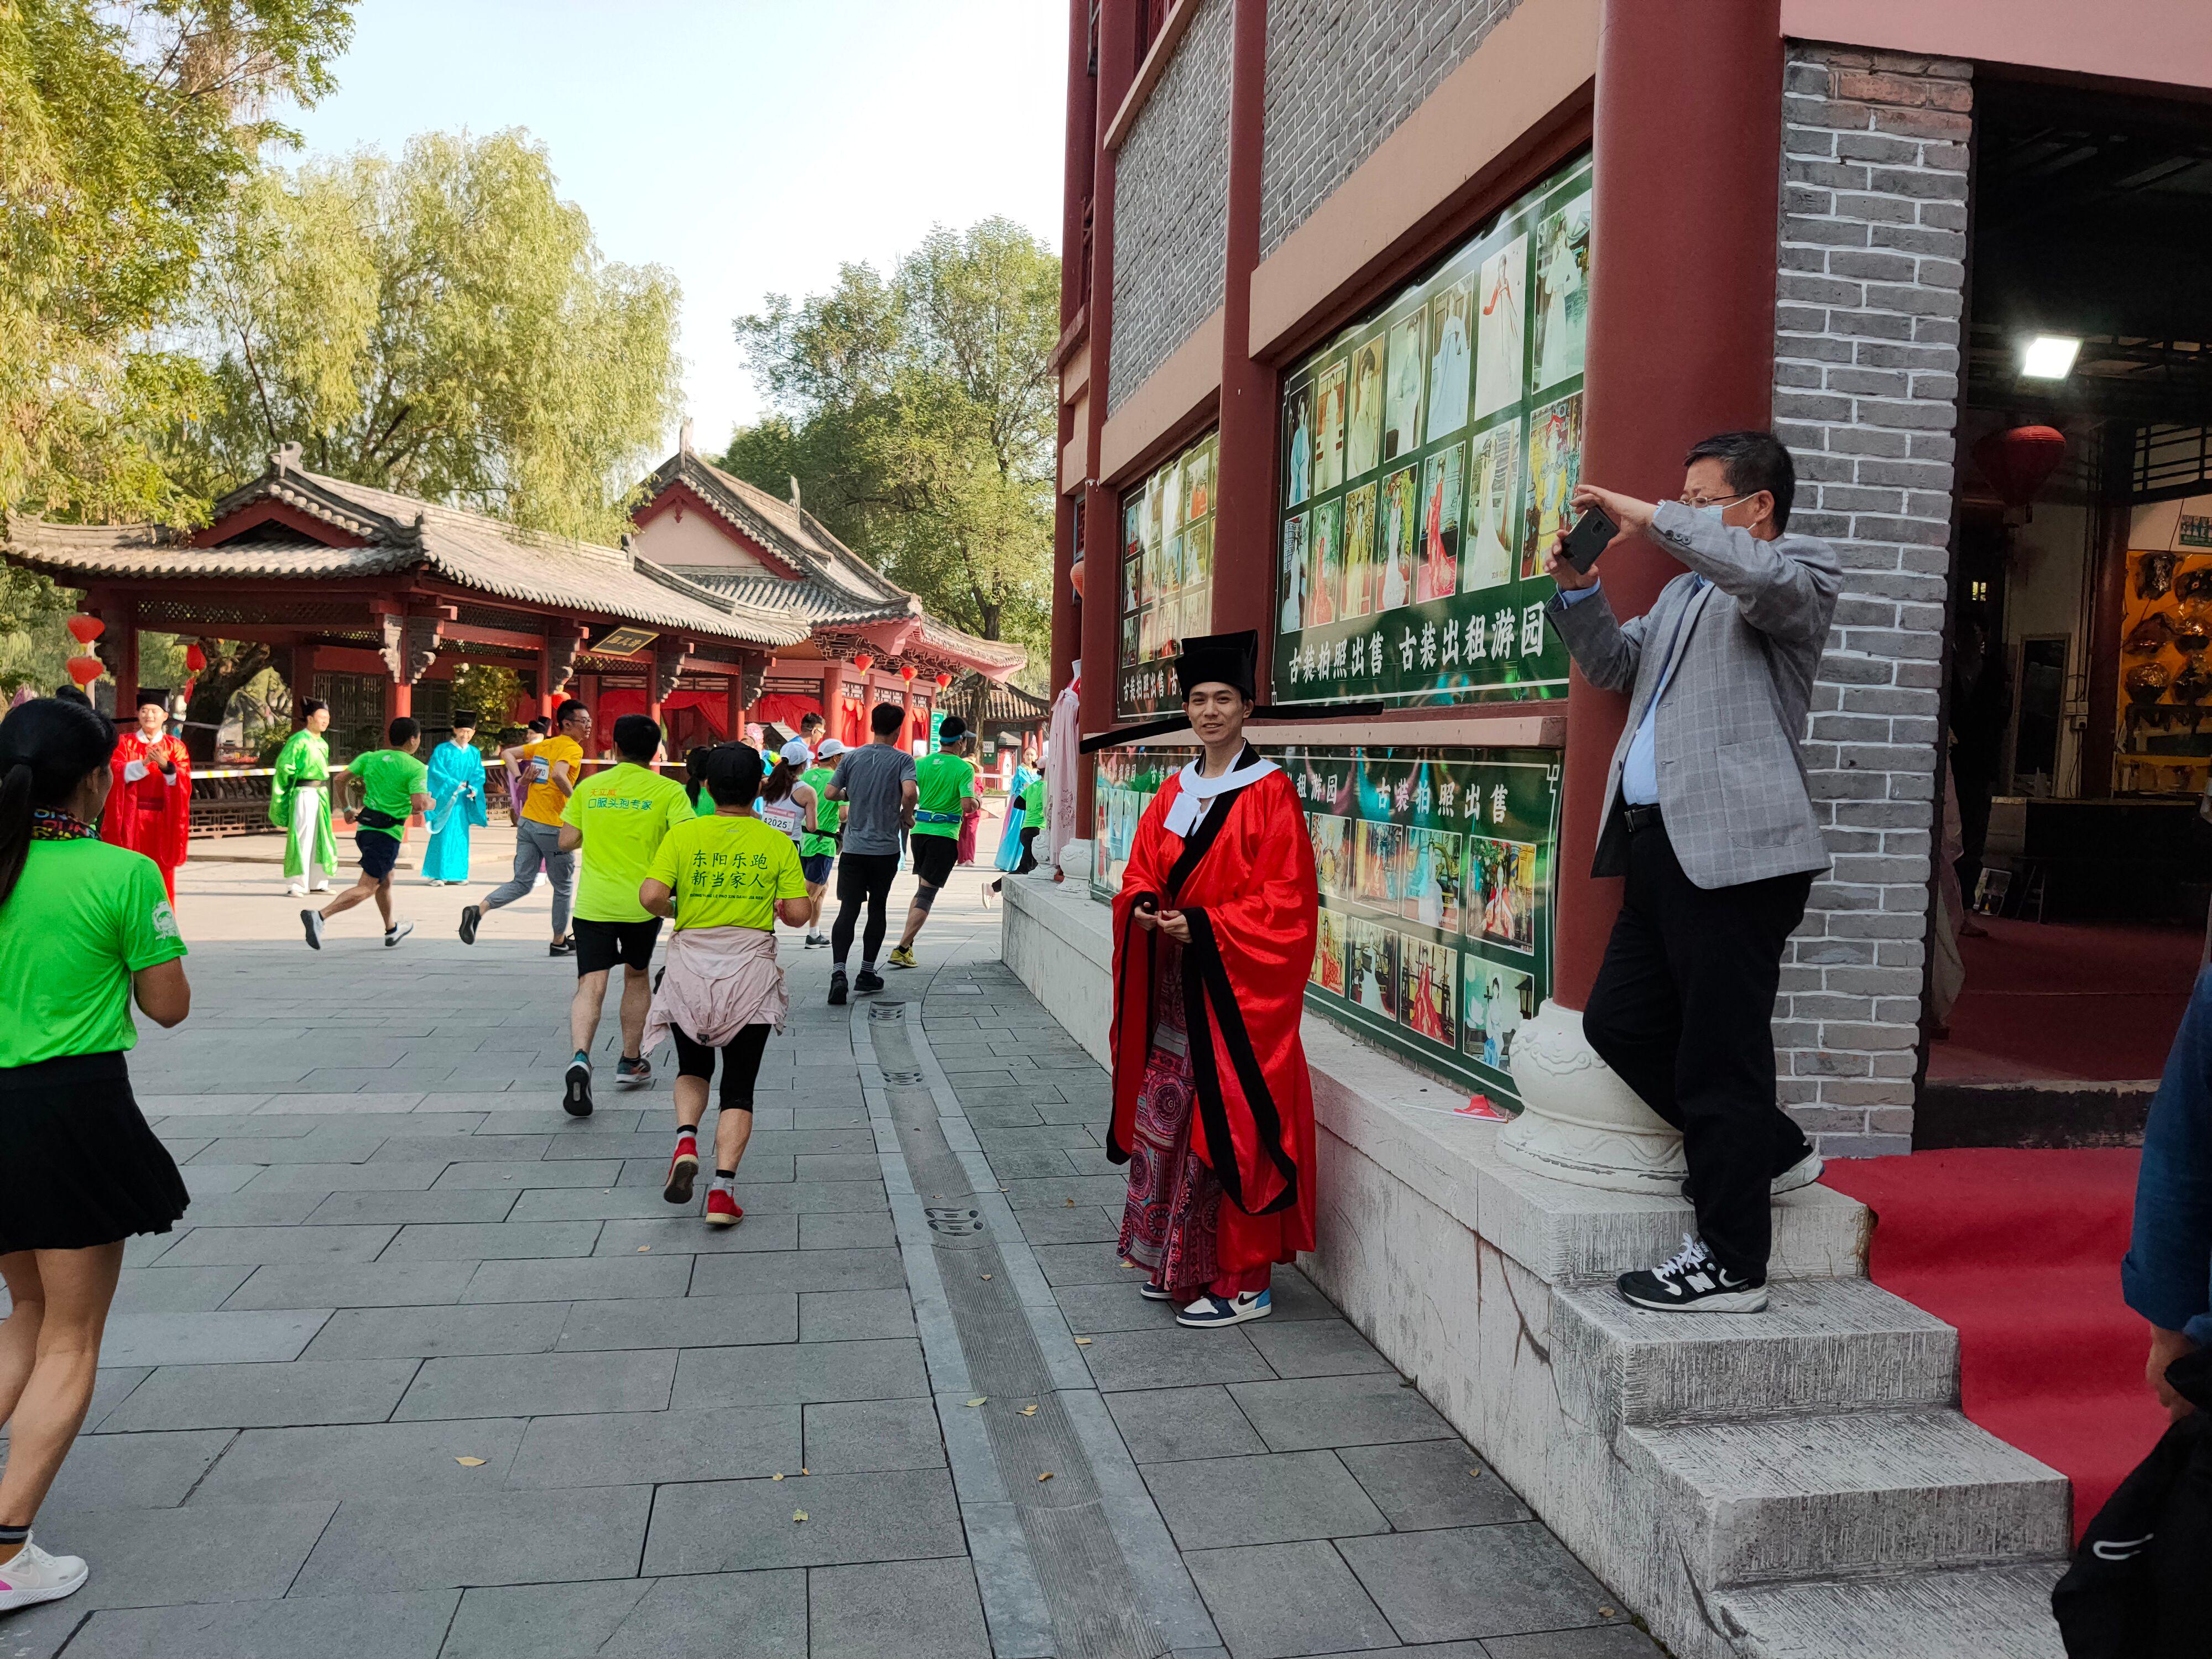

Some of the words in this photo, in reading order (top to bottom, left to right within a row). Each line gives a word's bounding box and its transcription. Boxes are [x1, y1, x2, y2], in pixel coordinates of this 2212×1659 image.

[1288, 632, 1384, 685] 古装拍照出售
[1399, 600, 1545, 672] 古装出租游园
[1124, 669, 1164, 702] 古装拍照出售
[1376, 776, 1509, 825] 古装拍照出售
[693, 849, 768, 869] 东阳乐跑
[691, 870, 765, 889] 新当家人
[1684, 1272, 1716, 1293] N
